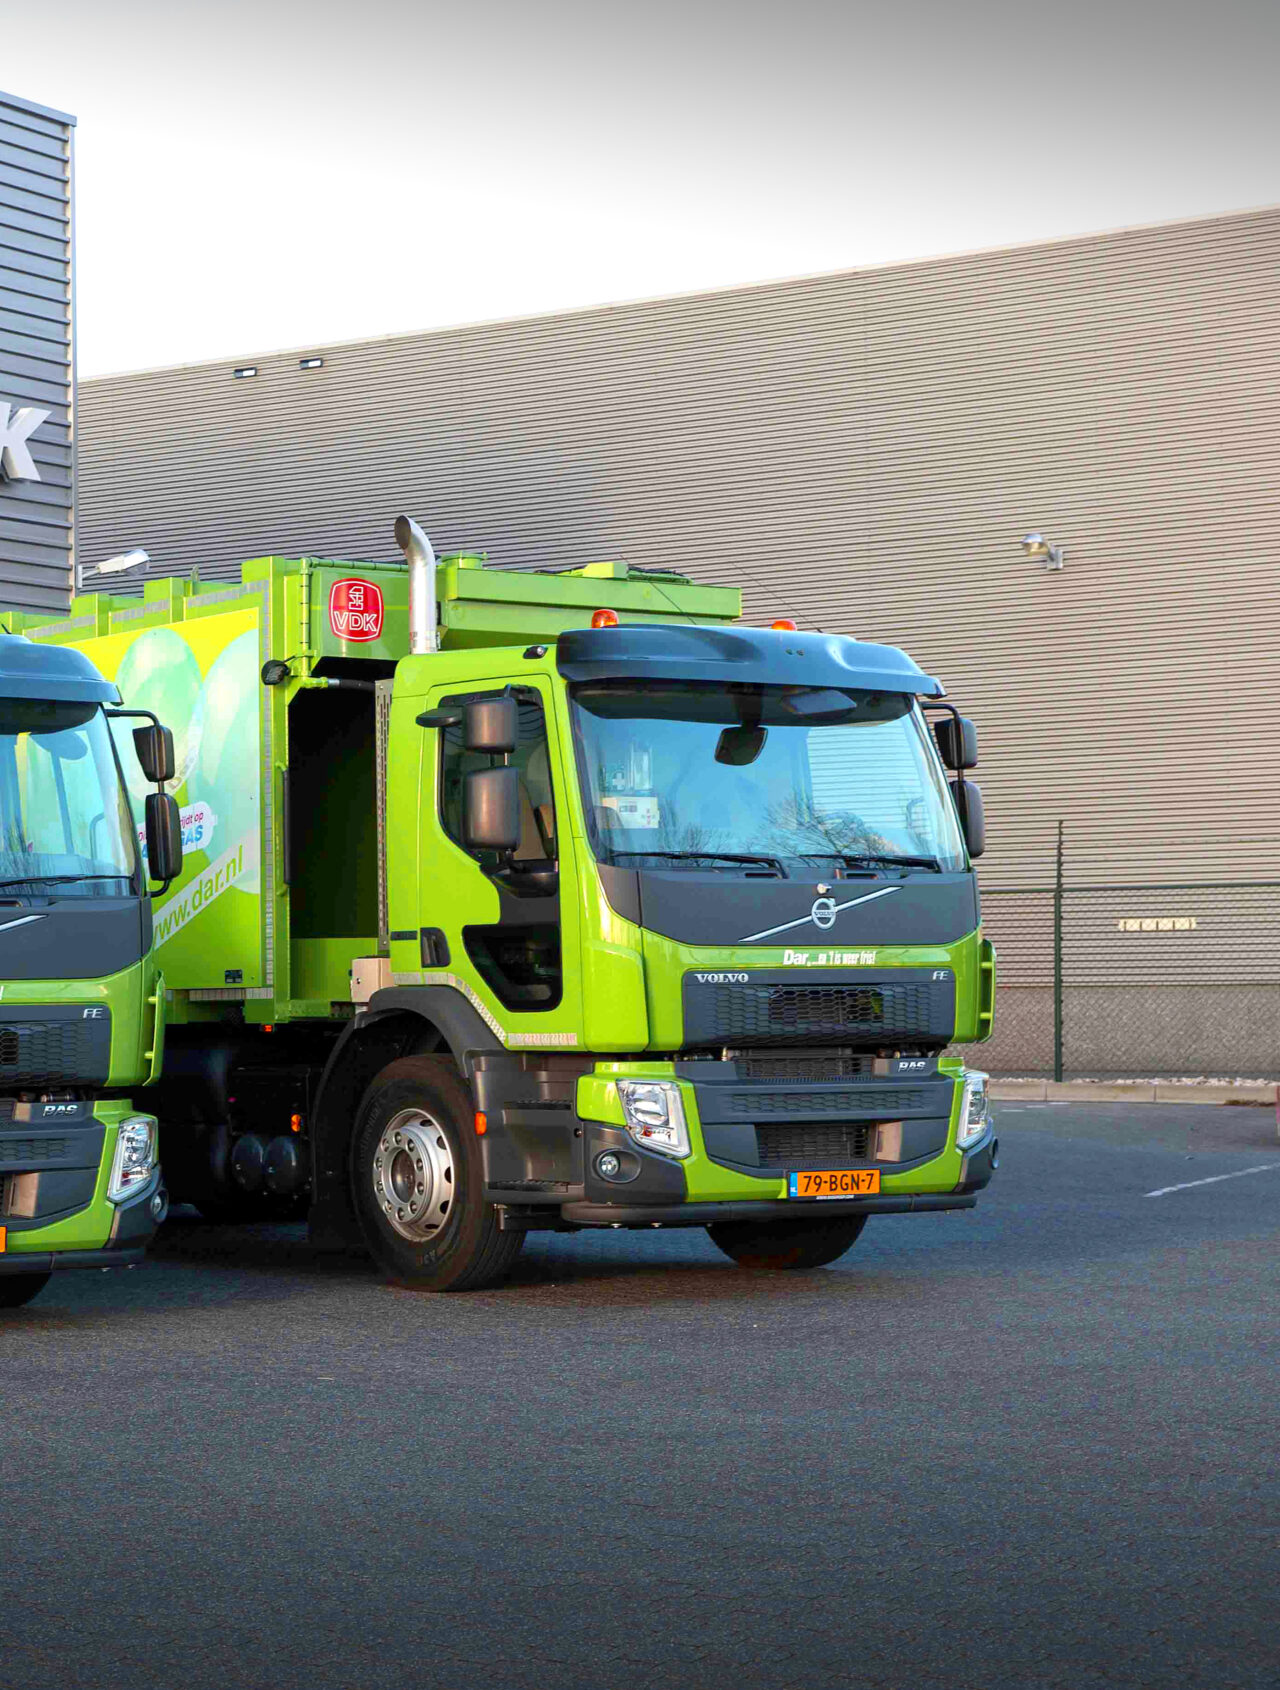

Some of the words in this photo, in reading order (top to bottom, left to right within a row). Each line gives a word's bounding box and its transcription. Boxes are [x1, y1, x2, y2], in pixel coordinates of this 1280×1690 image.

[333, 610, 378, 632] VDK
[694, 972, 749, 984] VOLVO
[932, 970, 949, 981] FE
[82, 1007, 104, 1019] FE
[803, 1173, 875, 1193] 79-BGN-7
